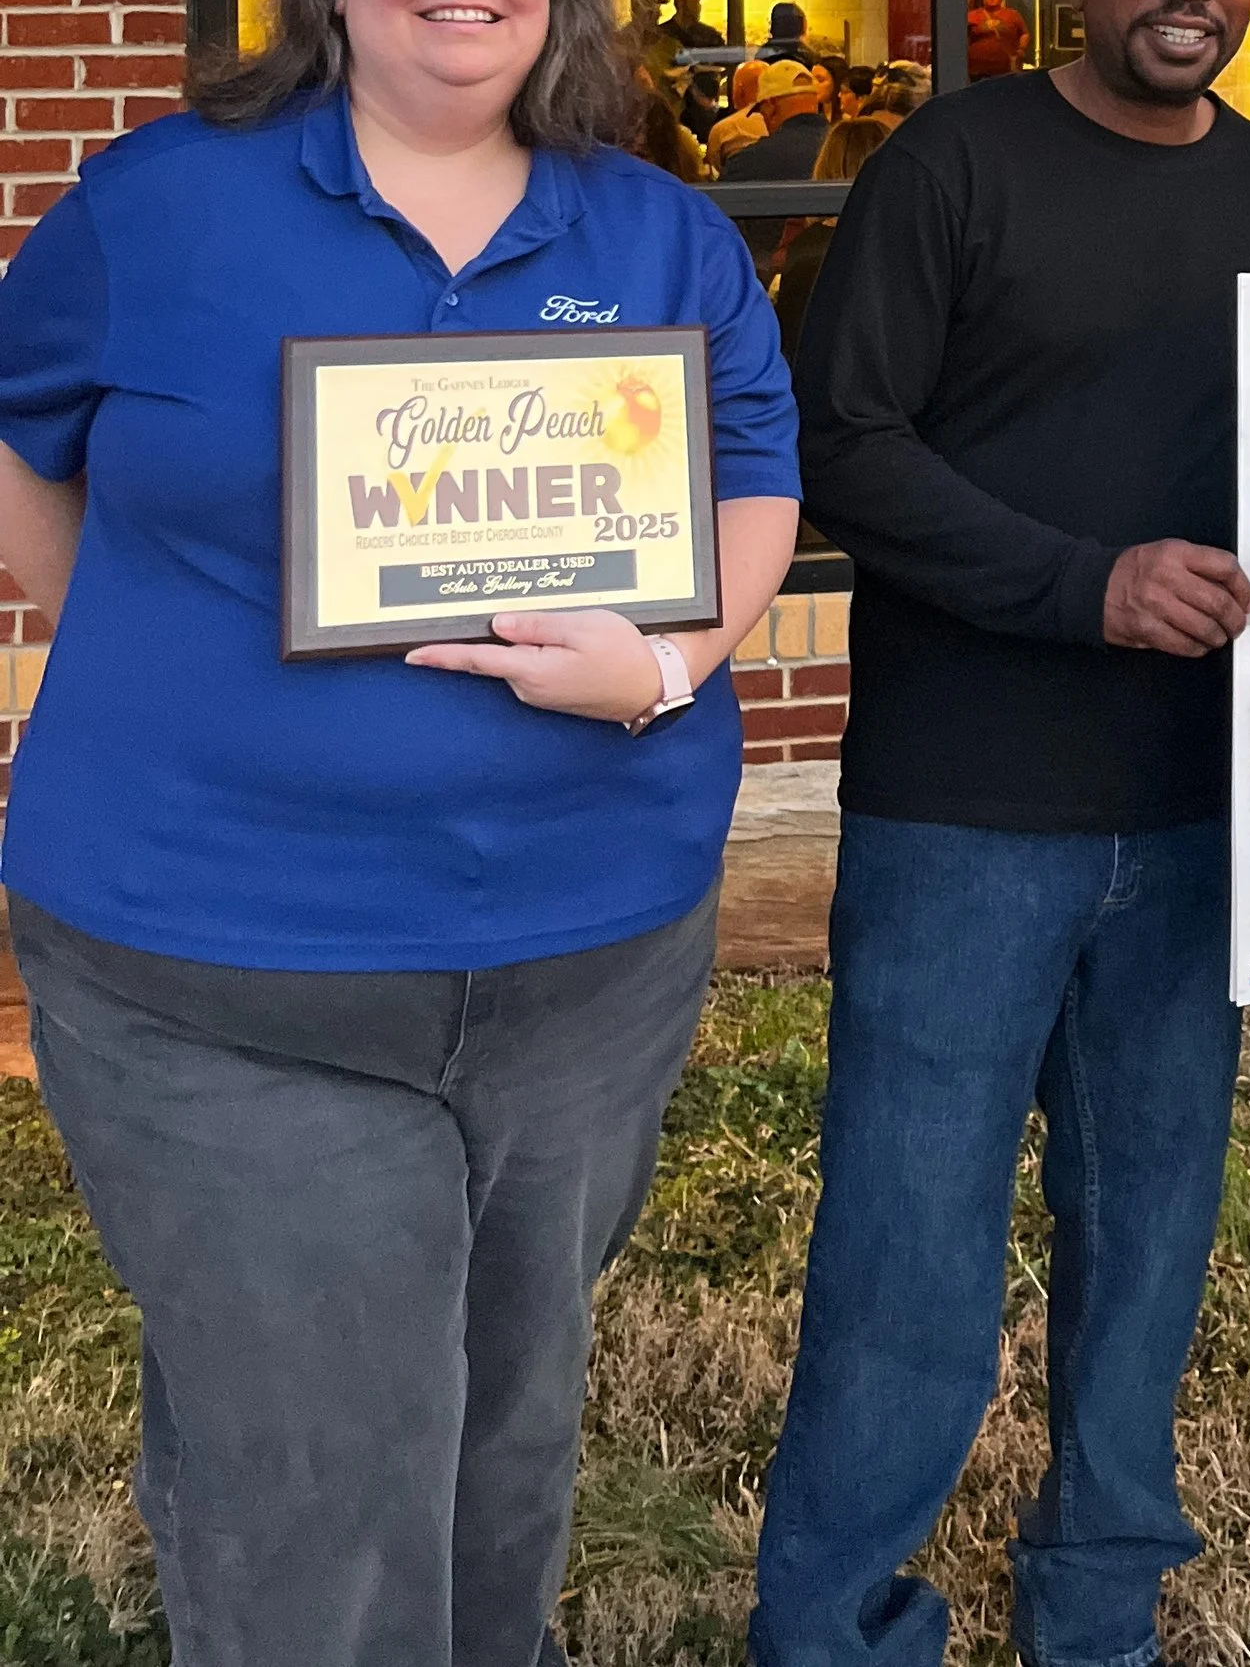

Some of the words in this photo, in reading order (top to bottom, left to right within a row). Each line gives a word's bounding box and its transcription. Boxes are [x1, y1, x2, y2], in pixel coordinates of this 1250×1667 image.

[540, 295, 620, 324] Ford
[375, 395, 492, 470] Golden
[499, 387, 606, 455] Peach
[397, 533, 430, 548] CHOICE
[432, 532, 449, 545] FOR
[450, 530, 472, 544] BEST
[473, 530, 484, 543] OF
[486, 527, 529, 542] CHEROKEE
[531, 525, 564, 540] COUNTY
[593, 511, 681, 543] 2025
[421, 563, 456, 578] BEST
[456, 561, 495, 576] AUTO
[497, 558, 551, 574] DEALER
[559, 555, 595, 570] USED
[439, 580, 479, 596] Auto
[482, 575, 533, 595] Gallery
[536, 572, 576, 589] Ford
